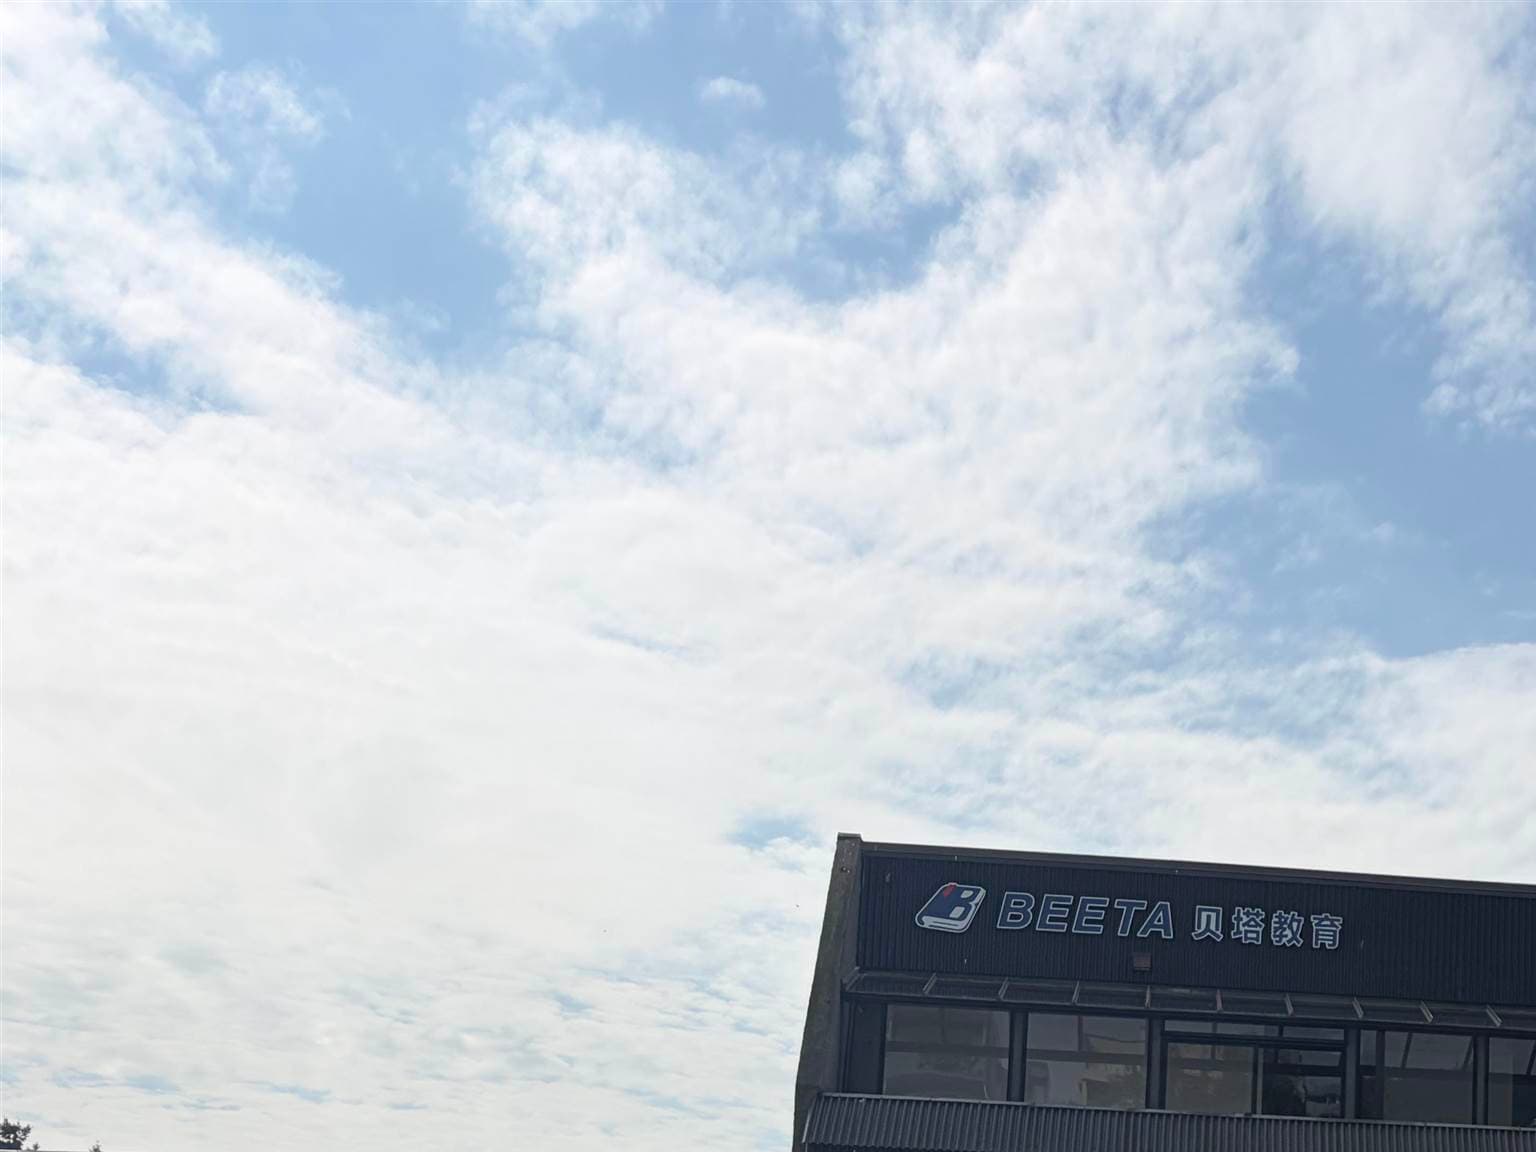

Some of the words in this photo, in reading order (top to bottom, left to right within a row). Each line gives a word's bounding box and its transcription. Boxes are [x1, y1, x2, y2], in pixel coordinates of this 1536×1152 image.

[997, 891, 1174, 939] BEETA
[1191, 905, 1344, 949] 贝塔教育
